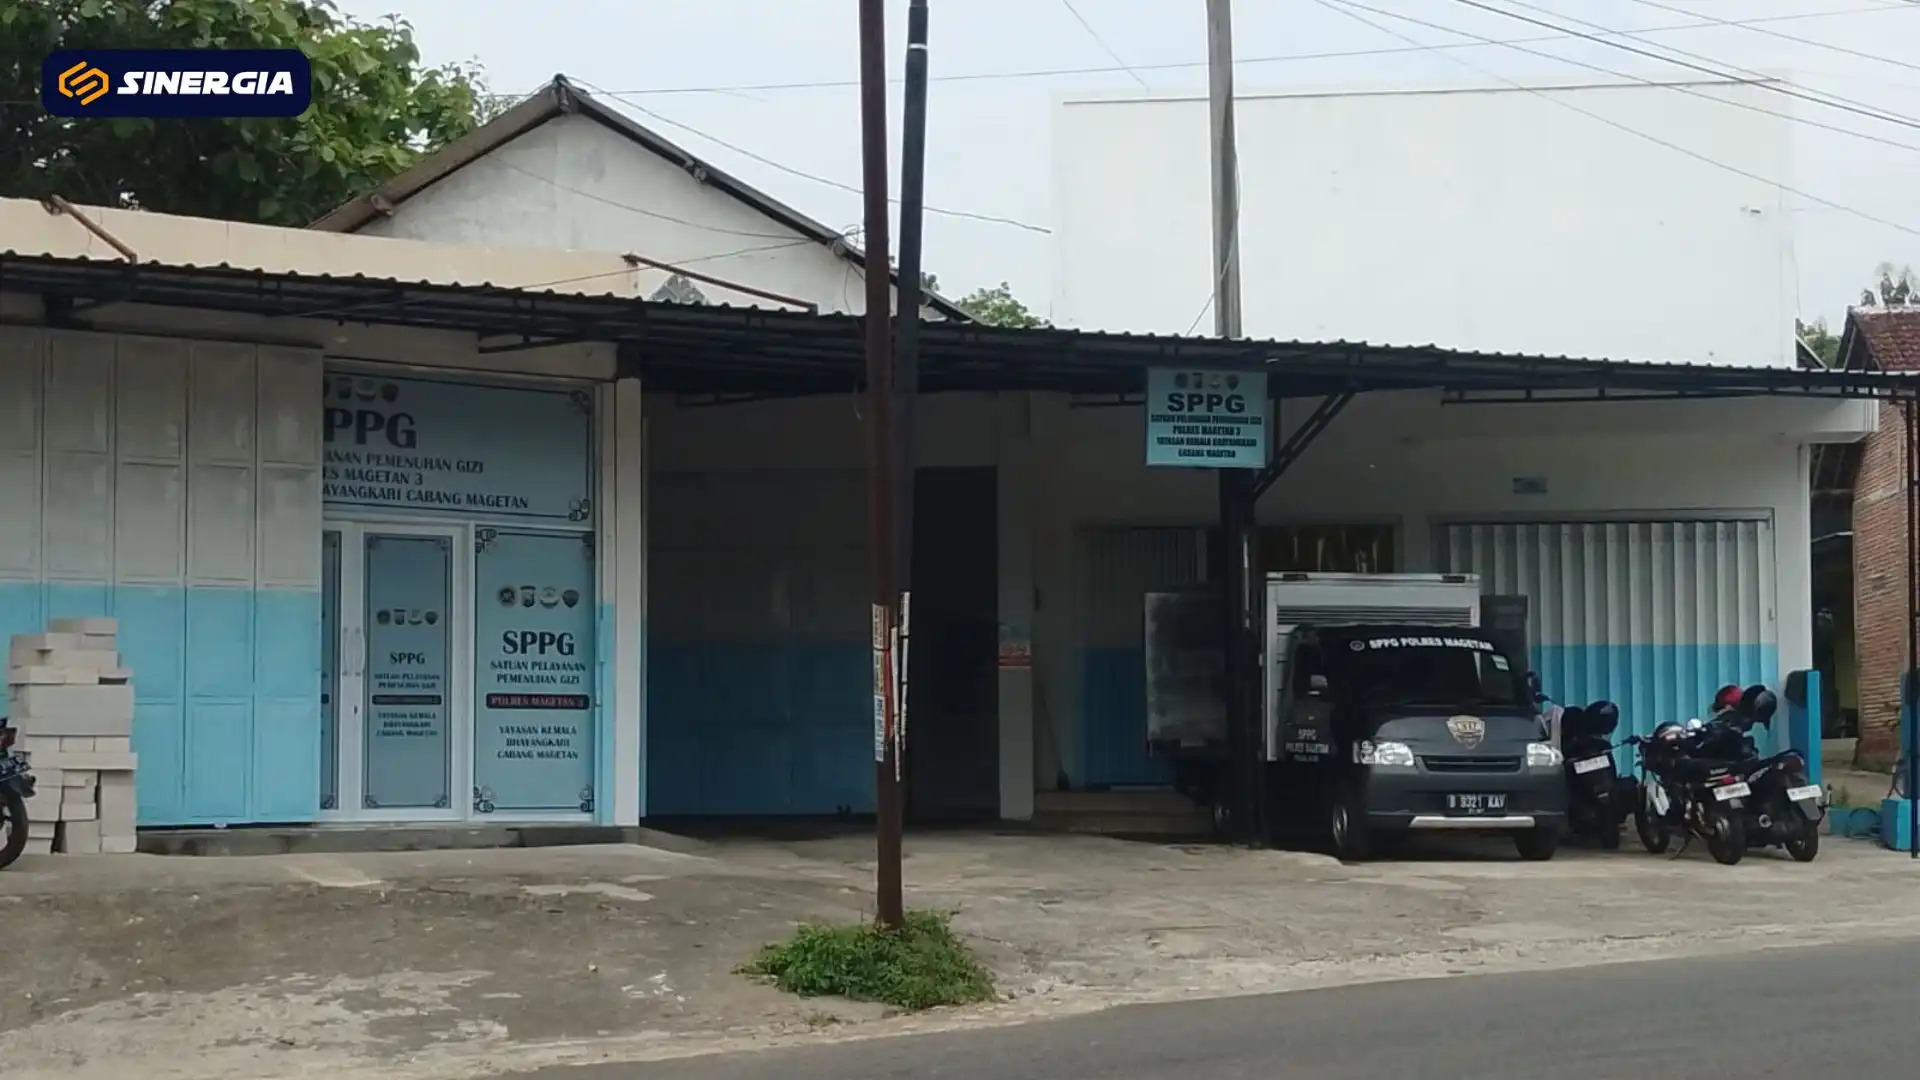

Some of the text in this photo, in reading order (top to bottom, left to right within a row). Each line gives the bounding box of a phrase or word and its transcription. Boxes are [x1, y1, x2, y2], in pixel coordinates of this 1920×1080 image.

[1167, 393, 1245, 413] SPPG
[323, 406, 417, 449] PPG
[366, 453, 452, 472] PEMENUHAN
[456, 459, 485, 474] GIZI
[345, 467, 410, 485] MAGETAN
[414, 473, 424, 486] 3
[323, 483, 529, 509] AYANGKARI CABANG MAGETAN
[502, 630, 575, 655] SPPG
[1368, 638, 1399, 649] SPPG
[1400, 636, 1442, 647] POLRES
[389, 652, 426, 665] SPPG
